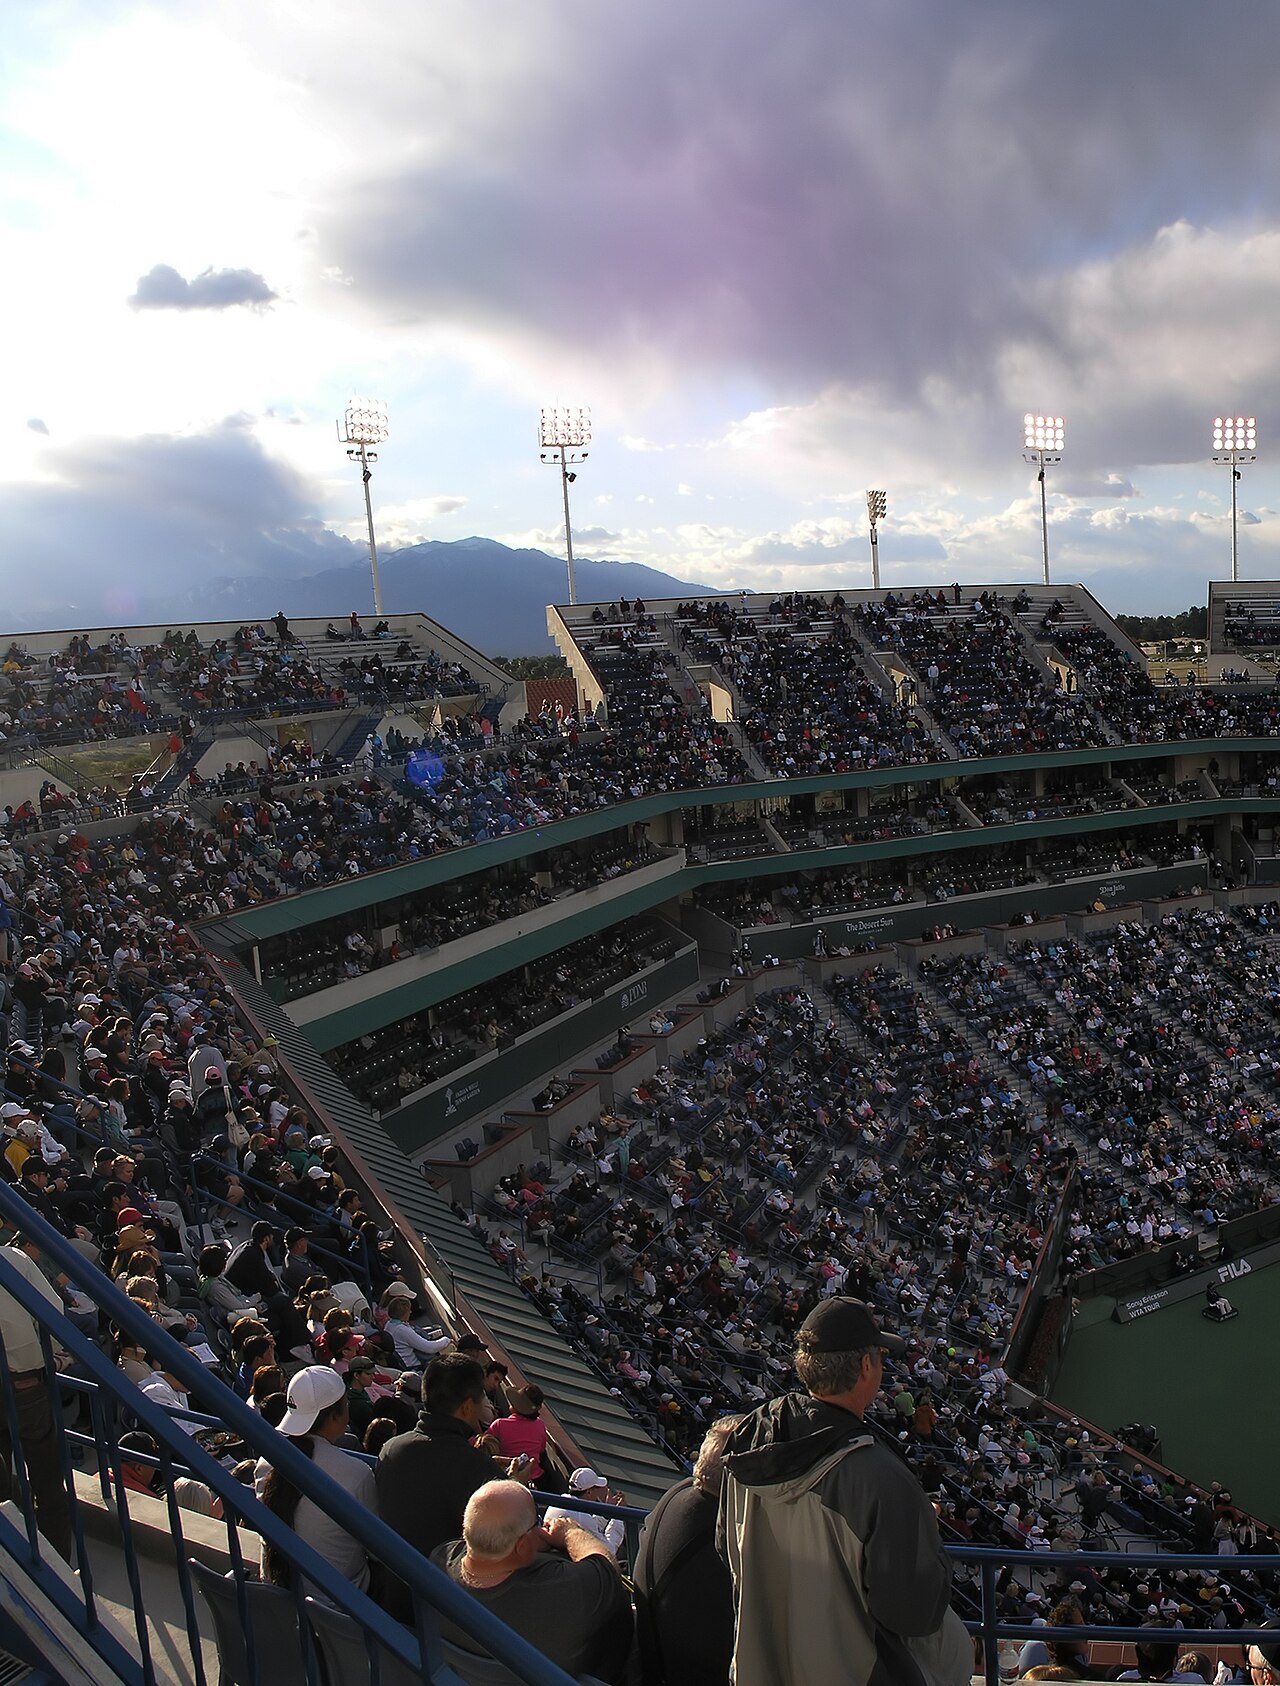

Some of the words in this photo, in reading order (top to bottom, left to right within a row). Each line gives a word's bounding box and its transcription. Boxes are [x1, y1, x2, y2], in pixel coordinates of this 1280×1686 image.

[846, 923, 858, 932] The
[858, 921, 880, 930] Desert
[880, 917, 894, 927] Sun
[1218, 1259, 1252, 1282] FILA
[1126, 1300, 1143, 1310] Sony
[1142, 1290, 1169, 1303] Ericsson
[1129, 1309, 1144, 1318] WTA
[1143, 1302, 1160, 1312] TOUR
